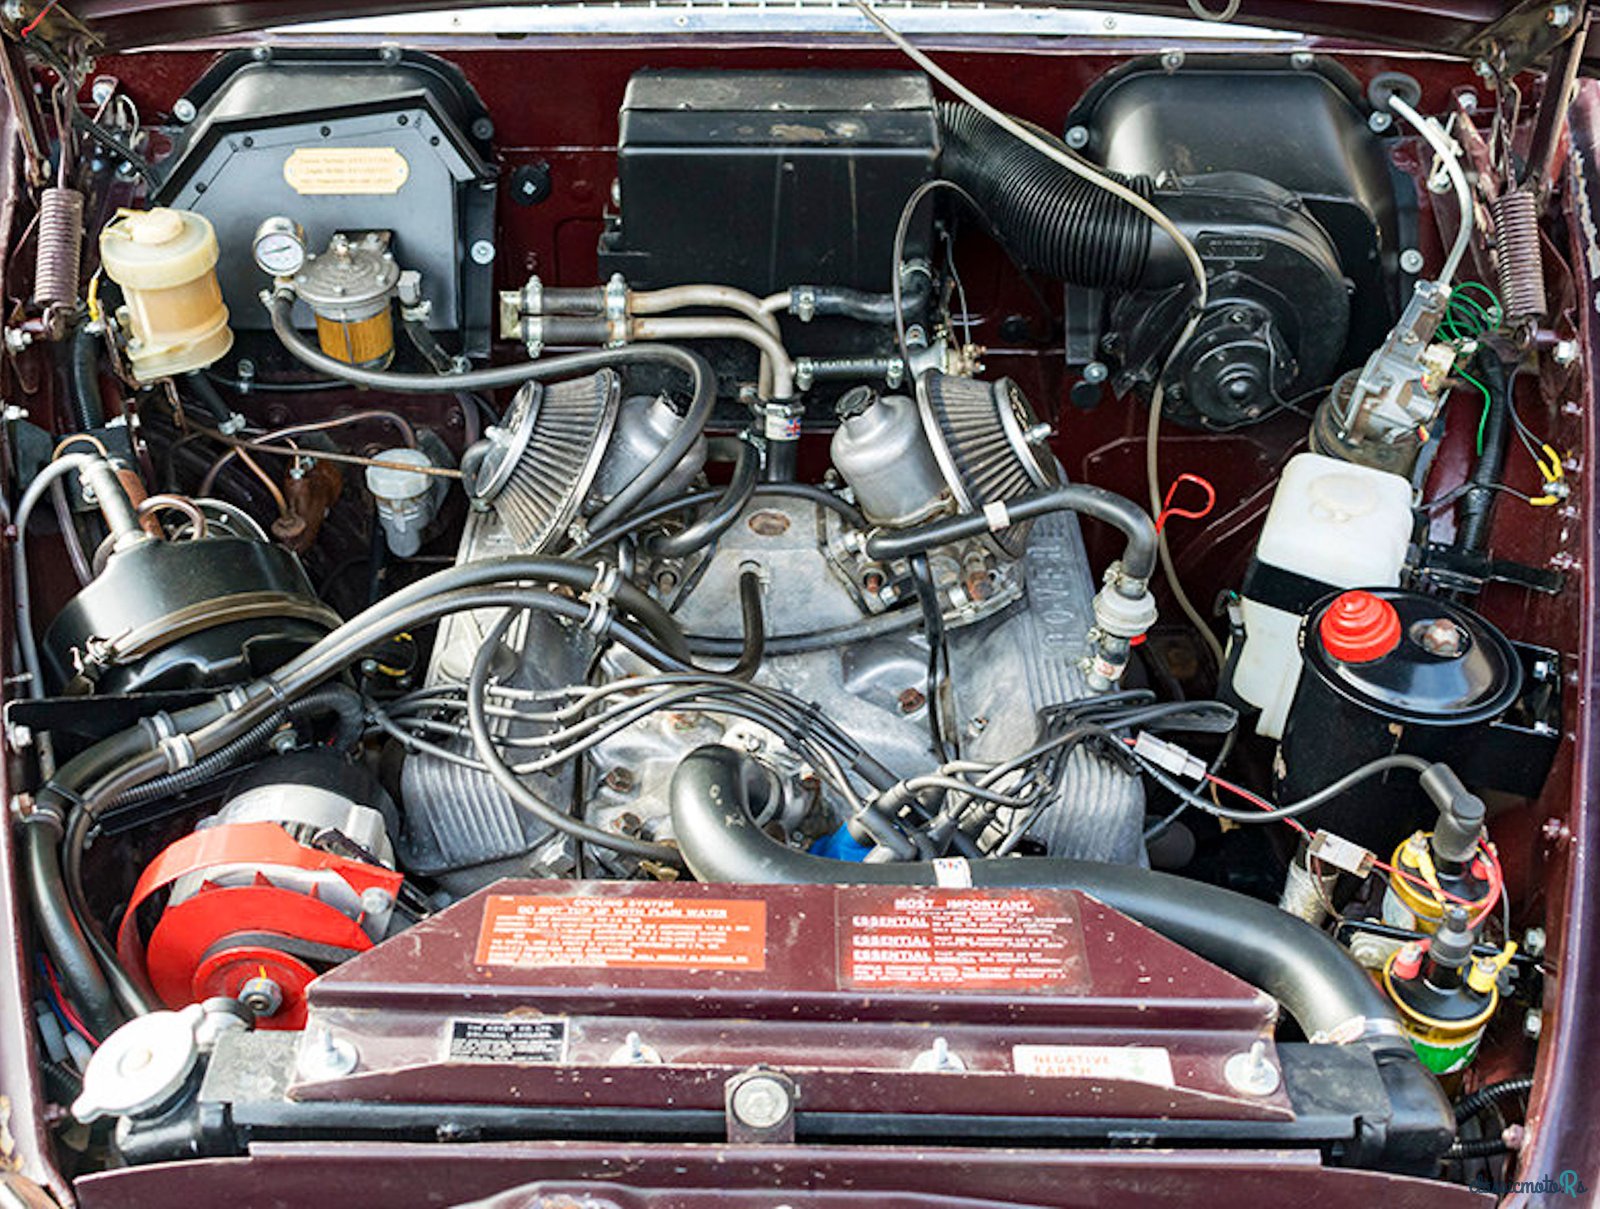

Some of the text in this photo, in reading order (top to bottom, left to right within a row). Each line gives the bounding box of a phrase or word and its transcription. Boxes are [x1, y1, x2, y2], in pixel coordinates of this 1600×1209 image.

[893, 898, 935, 910] MOST
[851, 915, 930, 928] ESSENTIAL
[851, 934, 931, 947] ESSENTIAL
[852, 949, 932, 962] ESSENTIAL
[1034, 1053, 1111, 1065] NEGATIVE
[1034, 1065, 1092, 1075] EARTH
